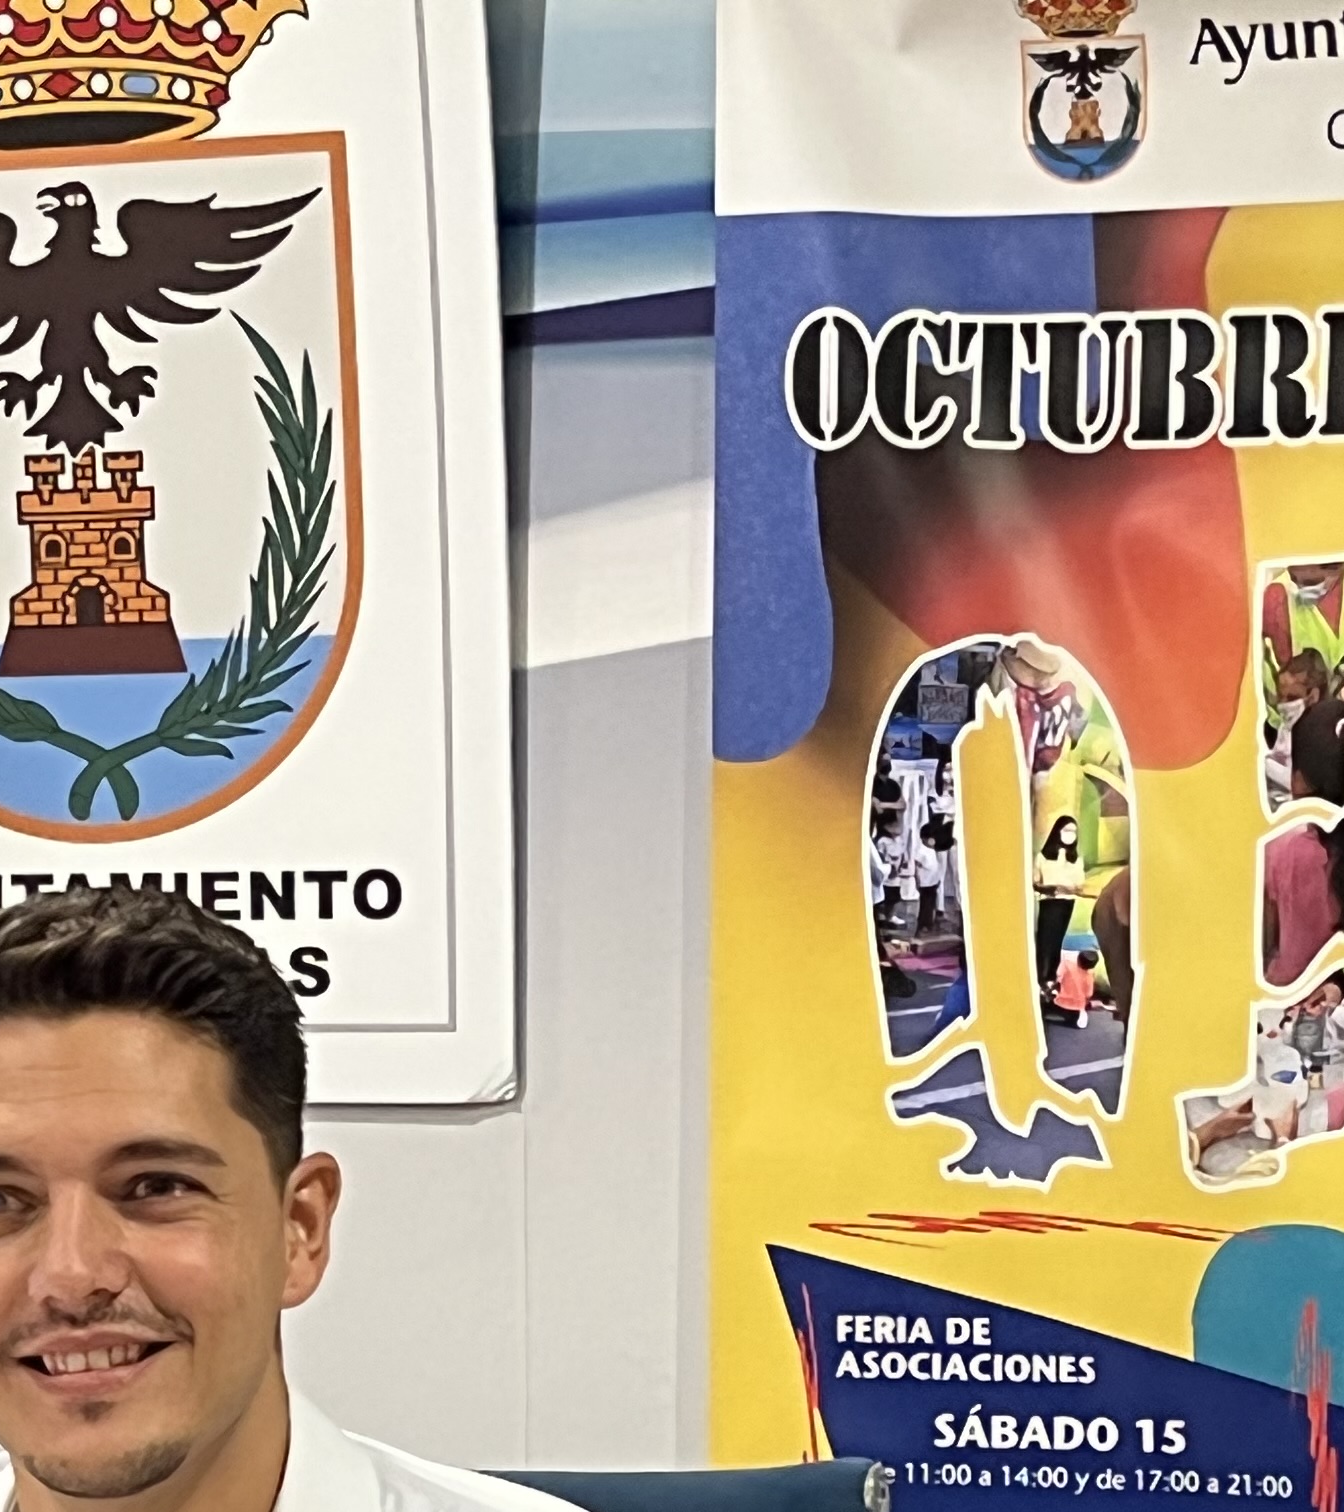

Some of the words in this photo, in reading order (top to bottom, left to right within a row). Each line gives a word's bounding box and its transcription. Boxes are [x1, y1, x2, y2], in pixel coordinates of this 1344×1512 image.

[835, 1315, 933, 1345] FERIA
[946, 1317, 991, 1346] DE
[835, 1351, 1097, 1385] ASOCIACIONES
[933, 1404, 1119, 1453] SÁBADO
[1135, 1417, 1188, 1455] 15
[904, 1462, 973, 1487] 11:00
[978, 1469, 992, 1487] a
[1001, 1465, 1069, 1490] 14:00
[1074, 1473, 1090, 1496] y
[1096, 1467, 1127, 1492] de
[1134, 1469, 1200, 1495] 17:00
[1207, 1476, 1220, 1495] a
[1227, 1472, 1293, 1499] 21:00
